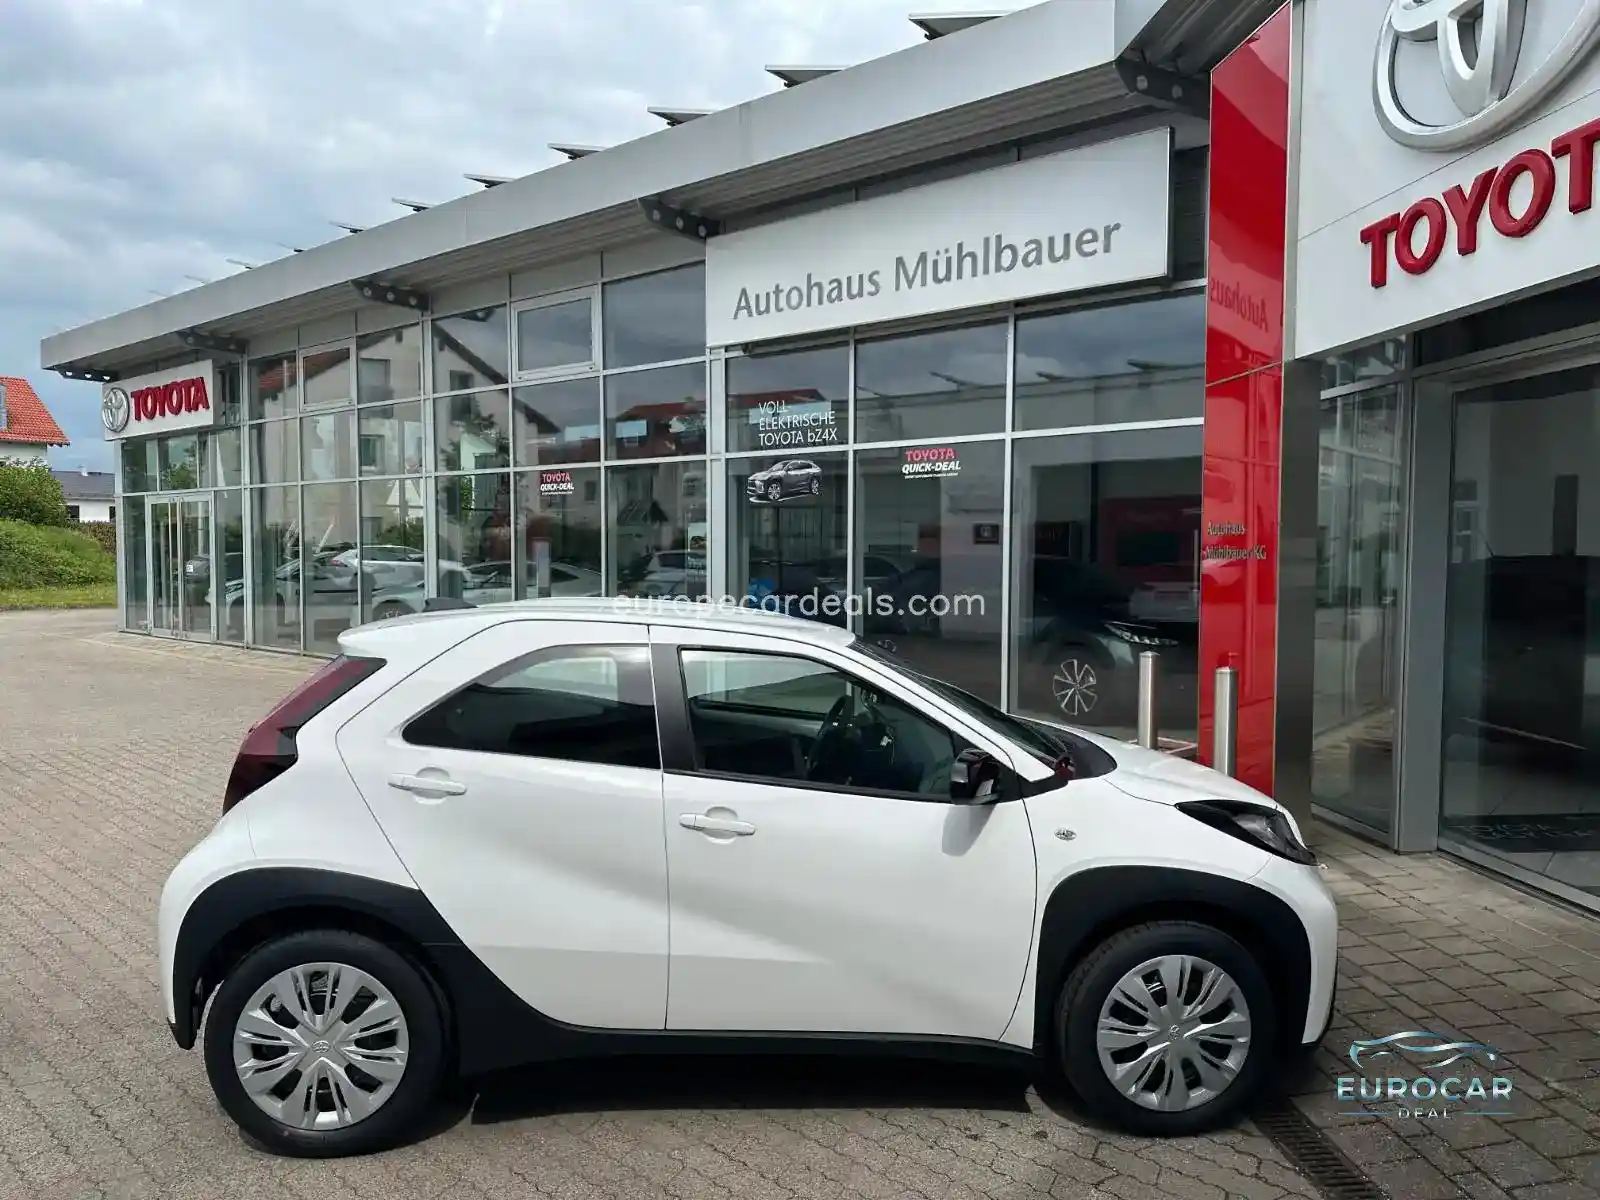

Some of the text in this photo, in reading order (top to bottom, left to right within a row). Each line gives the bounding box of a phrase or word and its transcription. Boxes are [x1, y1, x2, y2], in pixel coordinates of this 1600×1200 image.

[732, 222, 1122, 320] Autohaus Mühlbauer
[130, 376, 210, 421] TOYOTA
[759, 410, 836, 431] ELEKTRISCHE
[758, 427, 838, 446] TOYOTA bZ4X
[904, 447, 956, 462] TOYOTA
[901, 460, 962, 474] QUICK-DEAL
[542, 471, 571, 483] TOYOTA
[540, 481, 575, 492] QUICK-DEAL
